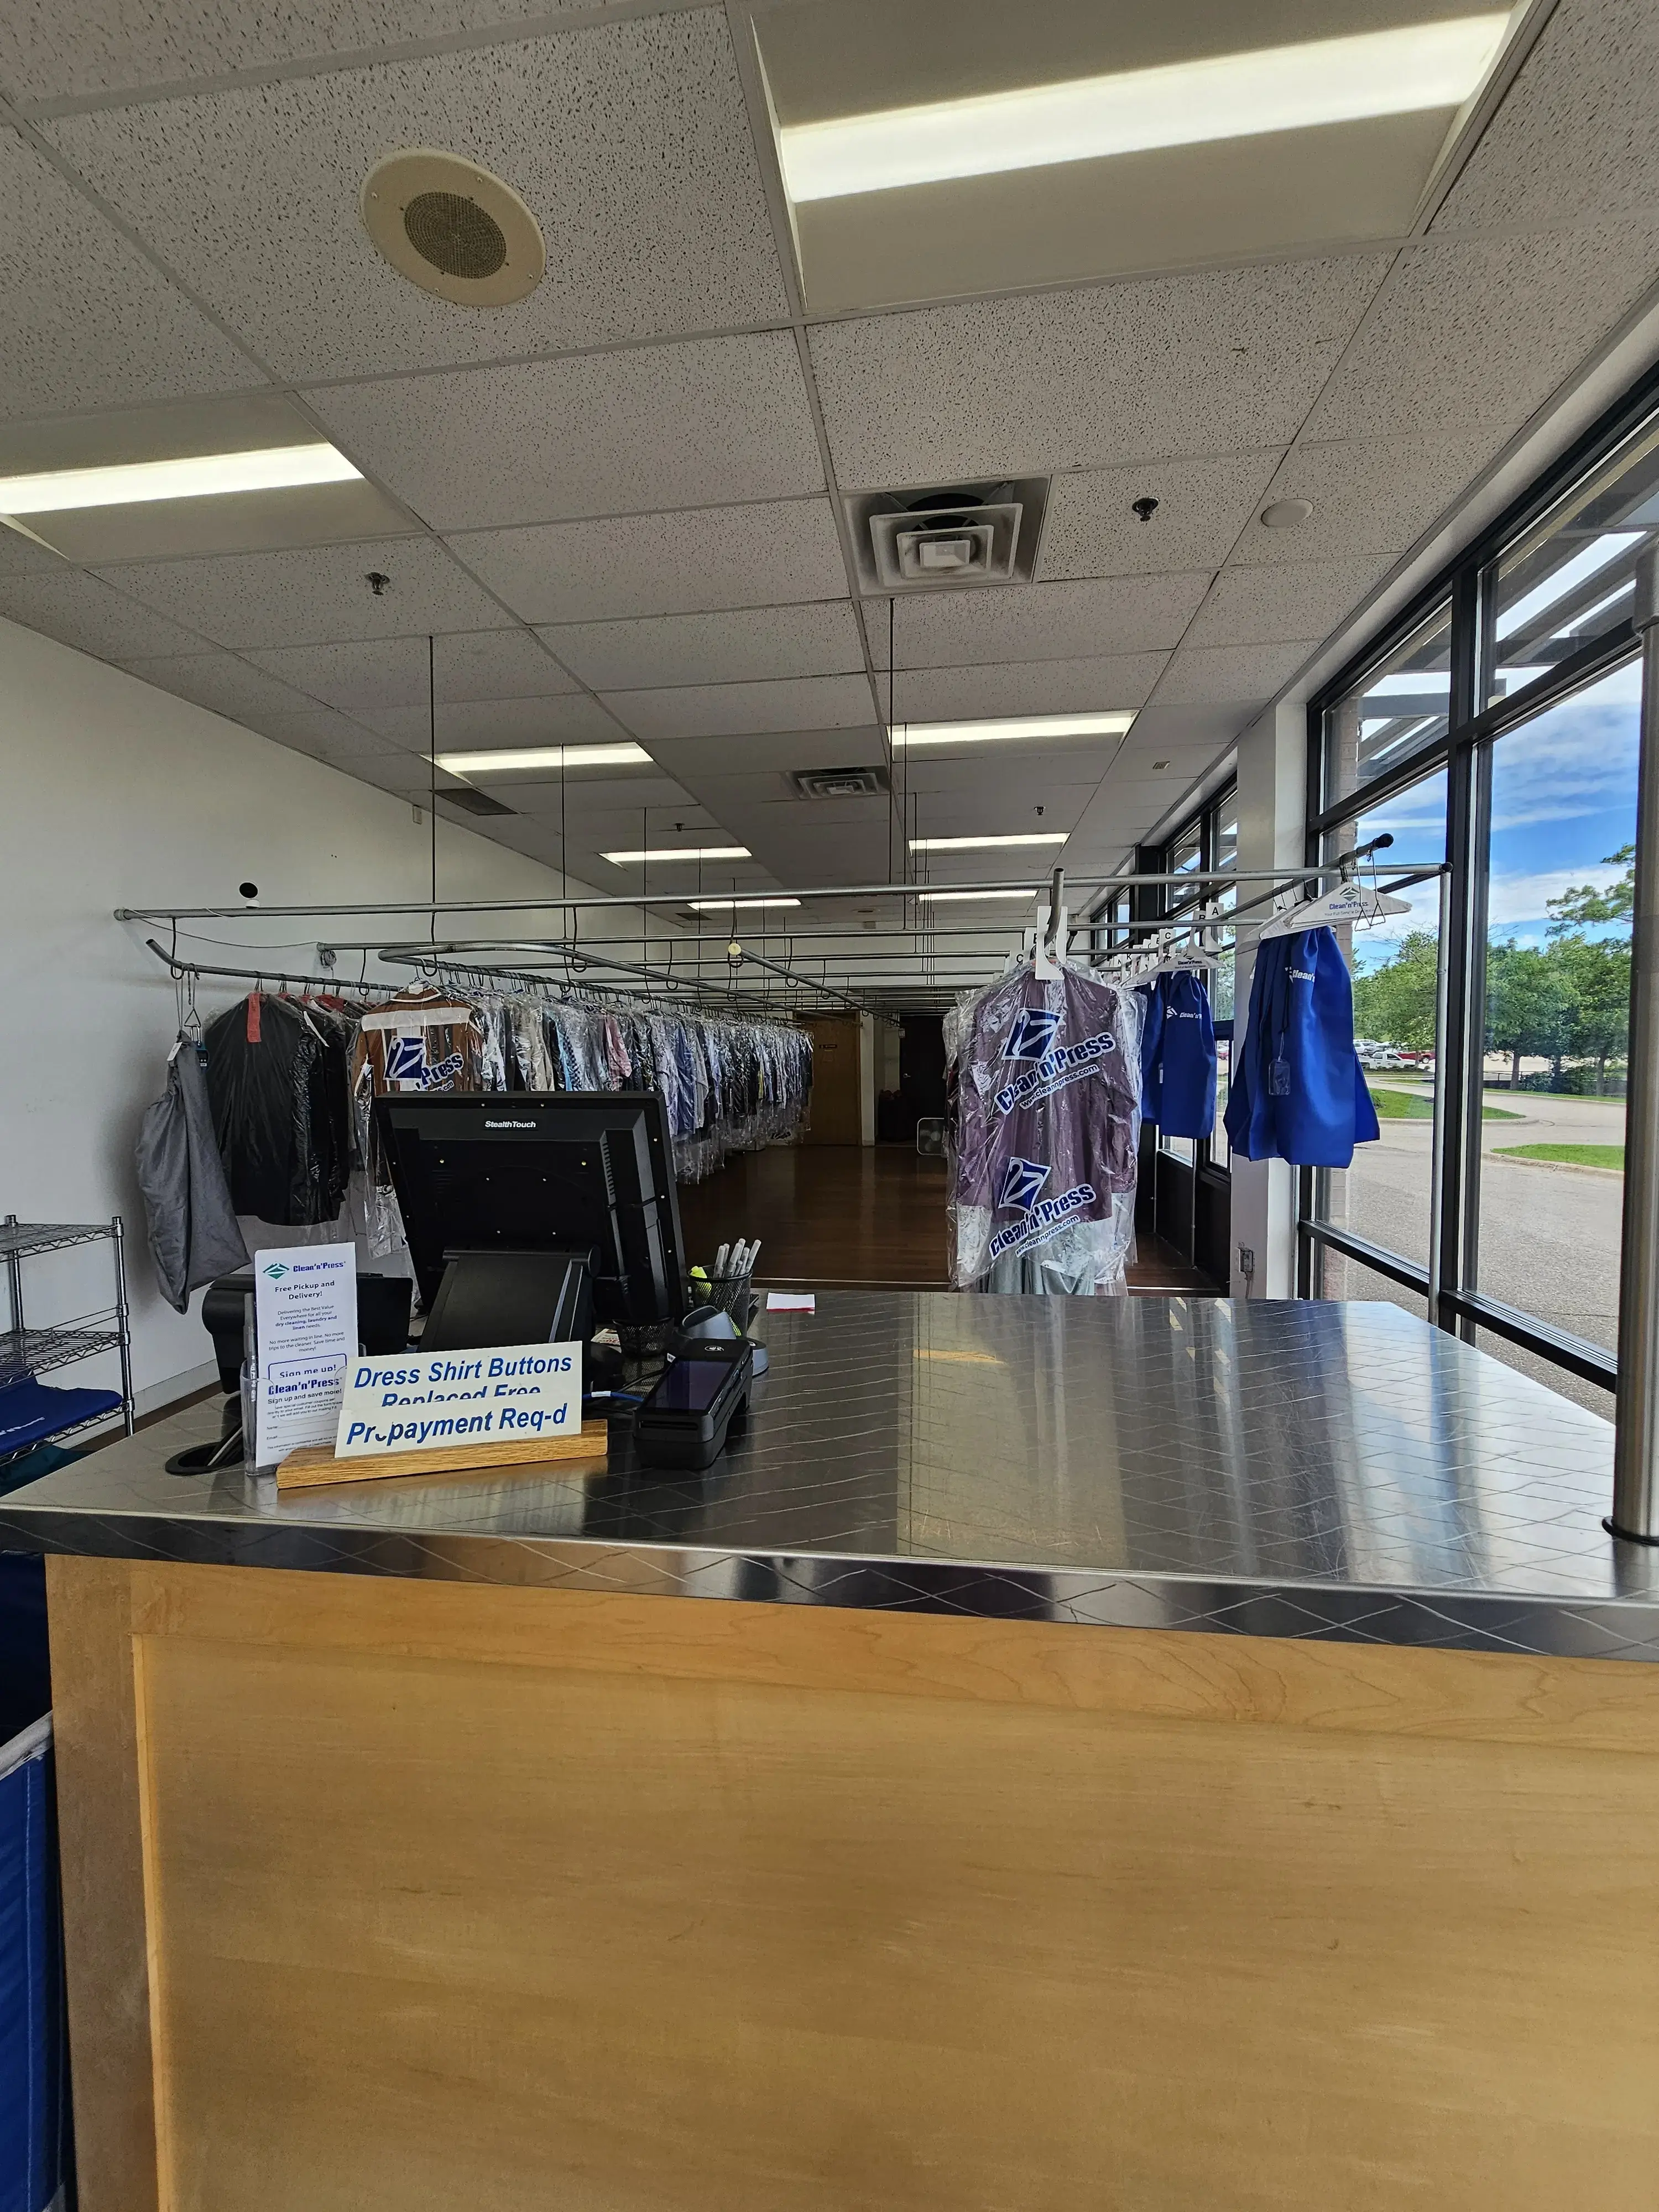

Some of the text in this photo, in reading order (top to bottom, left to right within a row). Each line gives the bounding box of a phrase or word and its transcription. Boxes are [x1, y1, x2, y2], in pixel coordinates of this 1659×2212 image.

[1212, 906, 1219, 915] A
[289, 1291, 322, 1300] Delivery!
[354, 1355, 572, 1388] Dress Shirt Buttons
